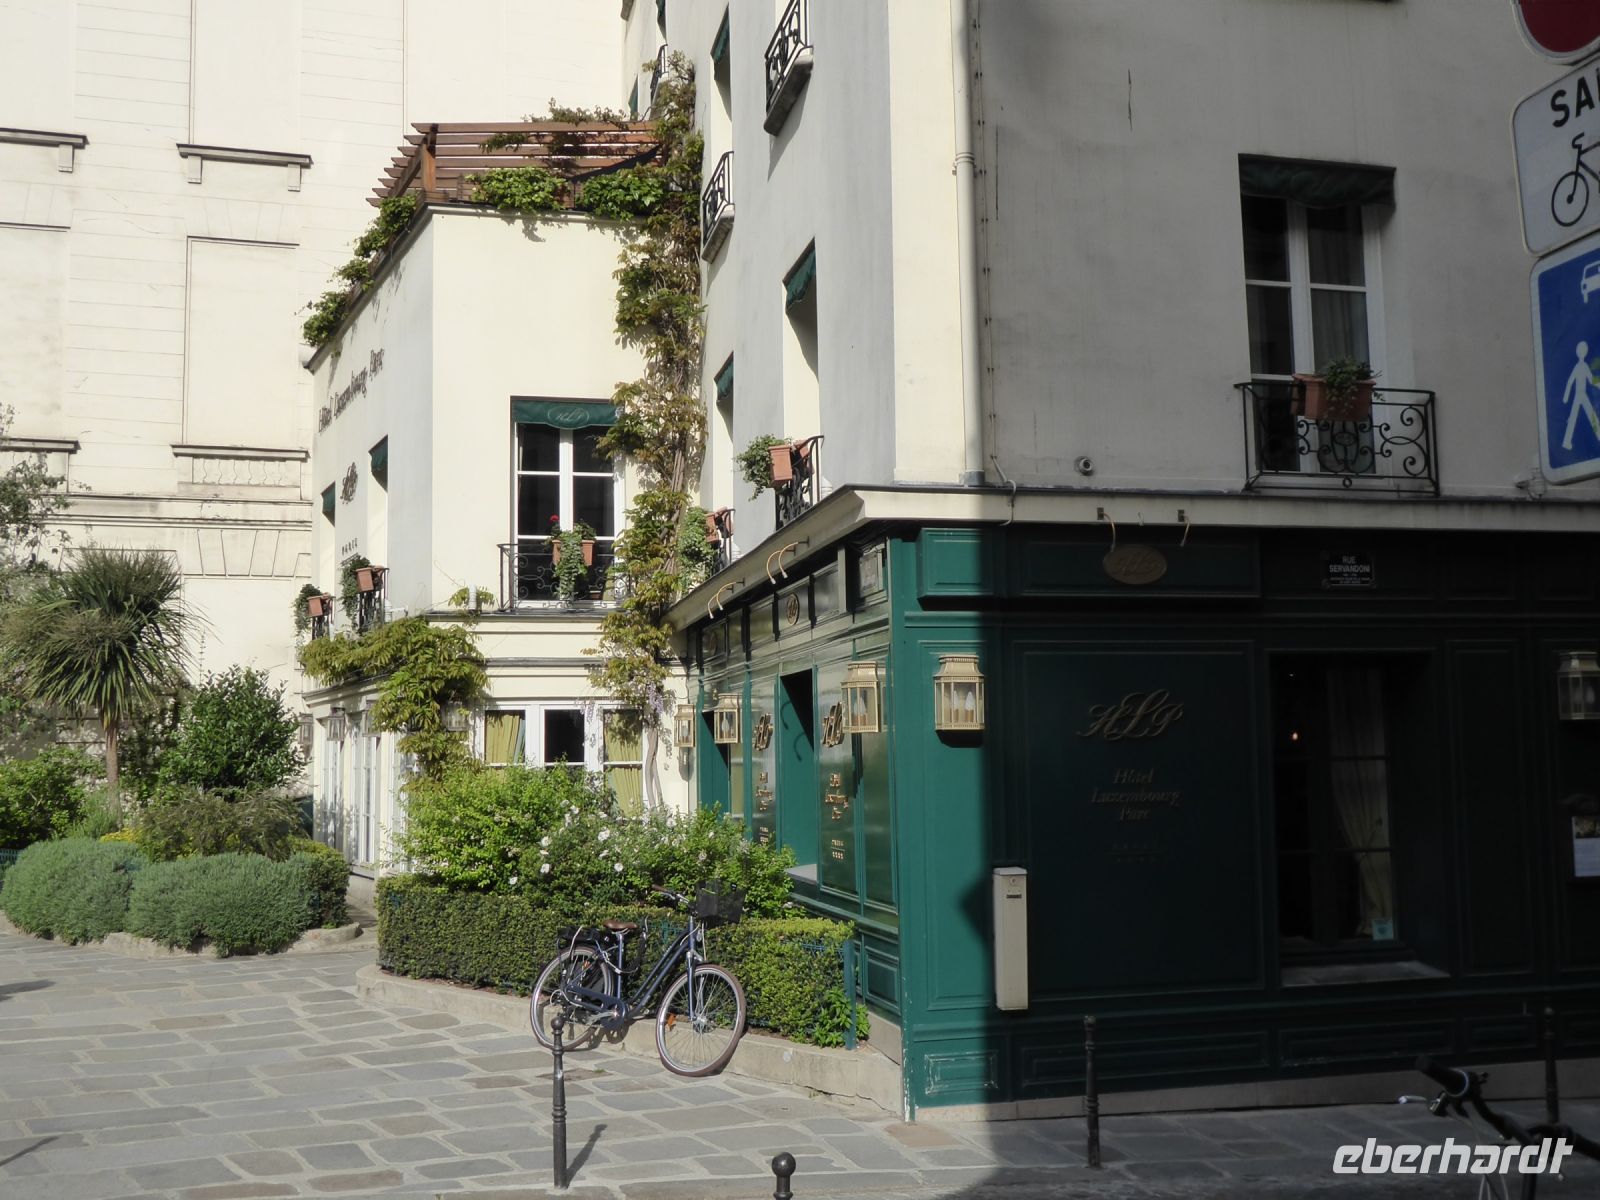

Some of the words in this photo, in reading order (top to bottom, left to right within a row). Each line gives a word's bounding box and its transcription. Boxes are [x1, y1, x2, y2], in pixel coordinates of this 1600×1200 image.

[1342, 555, 1356, 564] RUE
[1329, 564, 1370, 573] SERVANDONI
[1075, 688, 1184, 741] HLP
[1113, 767, 1155, 784] Hôtel
[1091, 787, 1182, 807] Luxembourg
[1120, 808, 1151, 822] Parc
